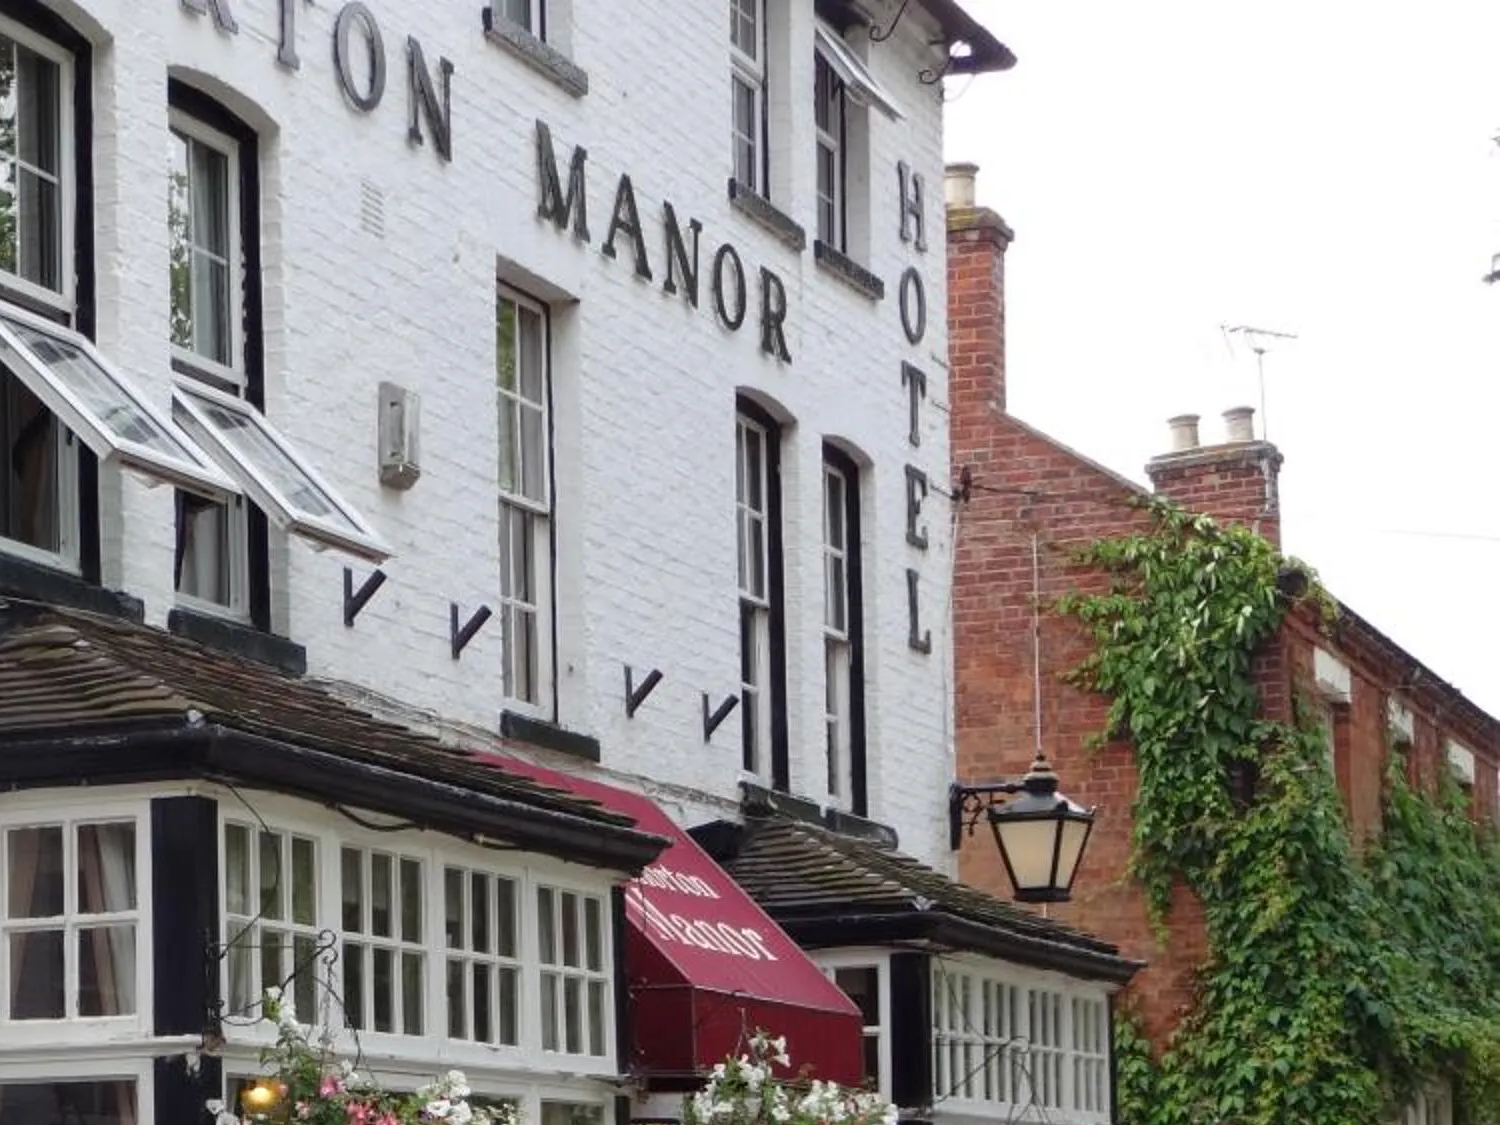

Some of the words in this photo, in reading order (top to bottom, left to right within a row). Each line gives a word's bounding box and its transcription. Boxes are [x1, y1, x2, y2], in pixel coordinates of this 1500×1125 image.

[180, 0, 453, 162] TON
[534, 117, 794, 366] MANOR
[896, 160, 932, 655] HOTEL
[625, 886, 779, 962] Manor
